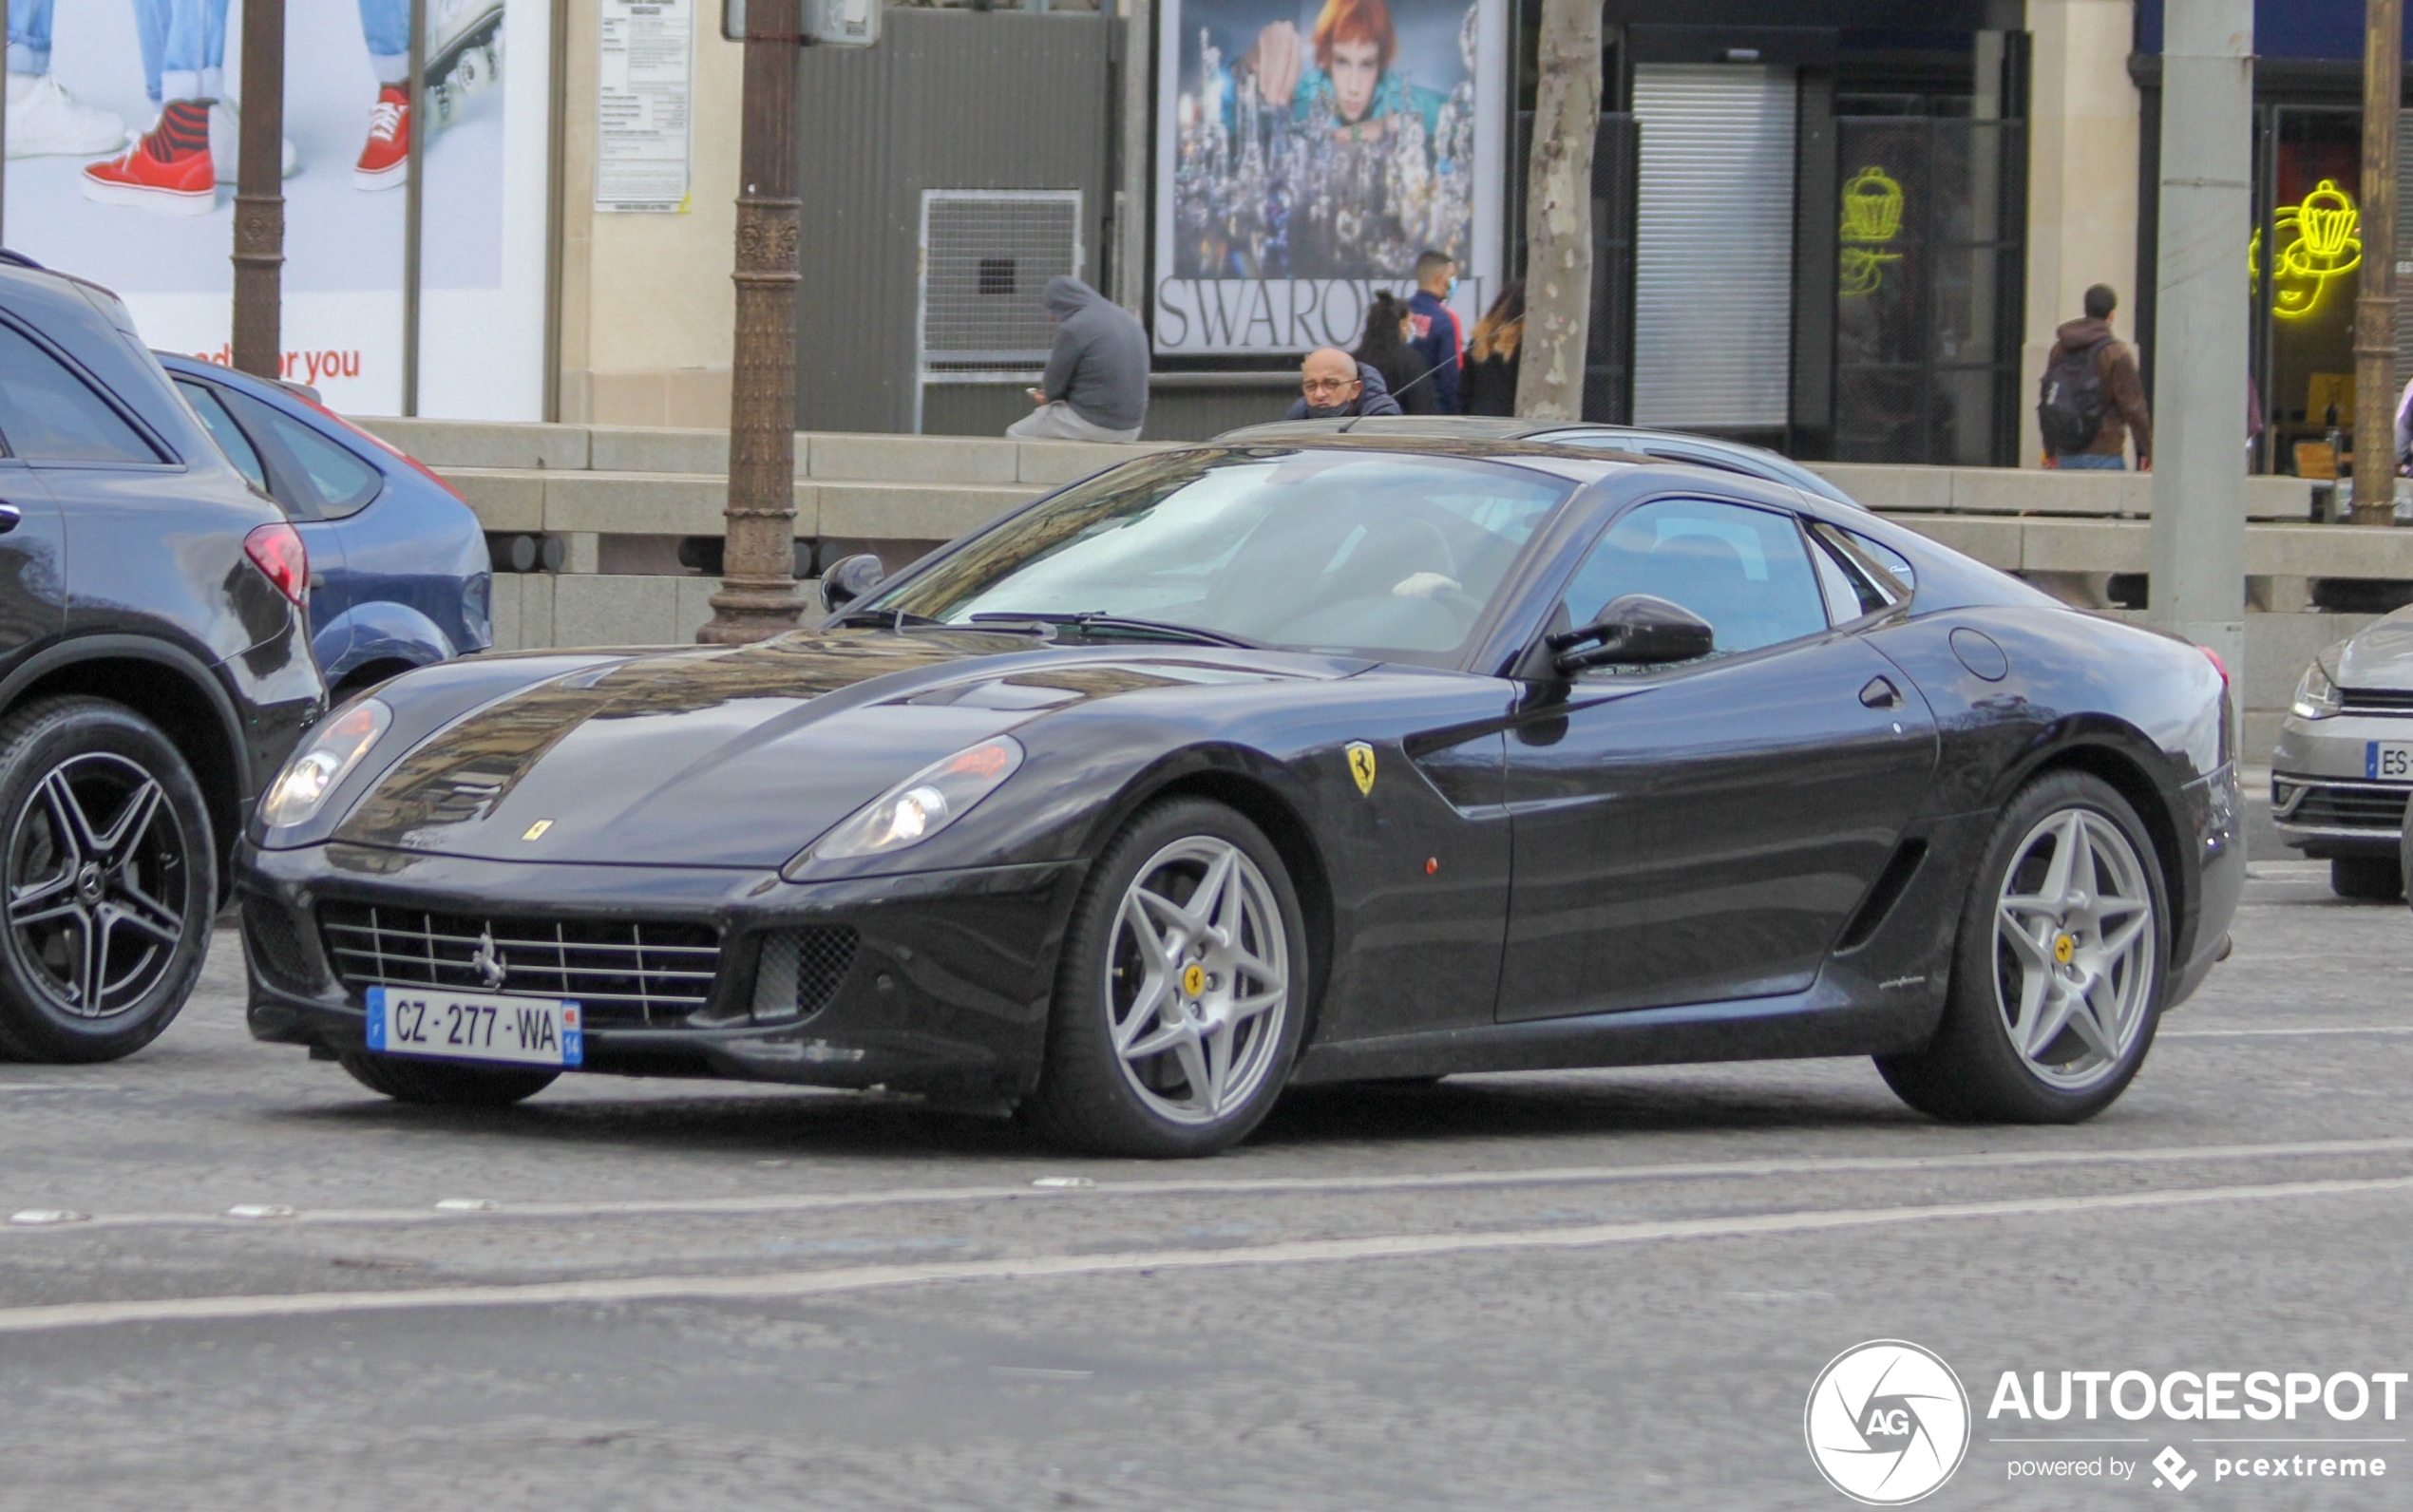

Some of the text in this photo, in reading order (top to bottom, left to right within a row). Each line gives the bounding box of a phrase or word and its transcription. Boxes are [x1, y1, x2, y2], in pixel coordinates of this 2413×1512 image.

[1158, 274, 1485, 348] SWAROI
[304, 350, 360, 387] you
[396, 999, 558, 1051] CZ-277-WA
